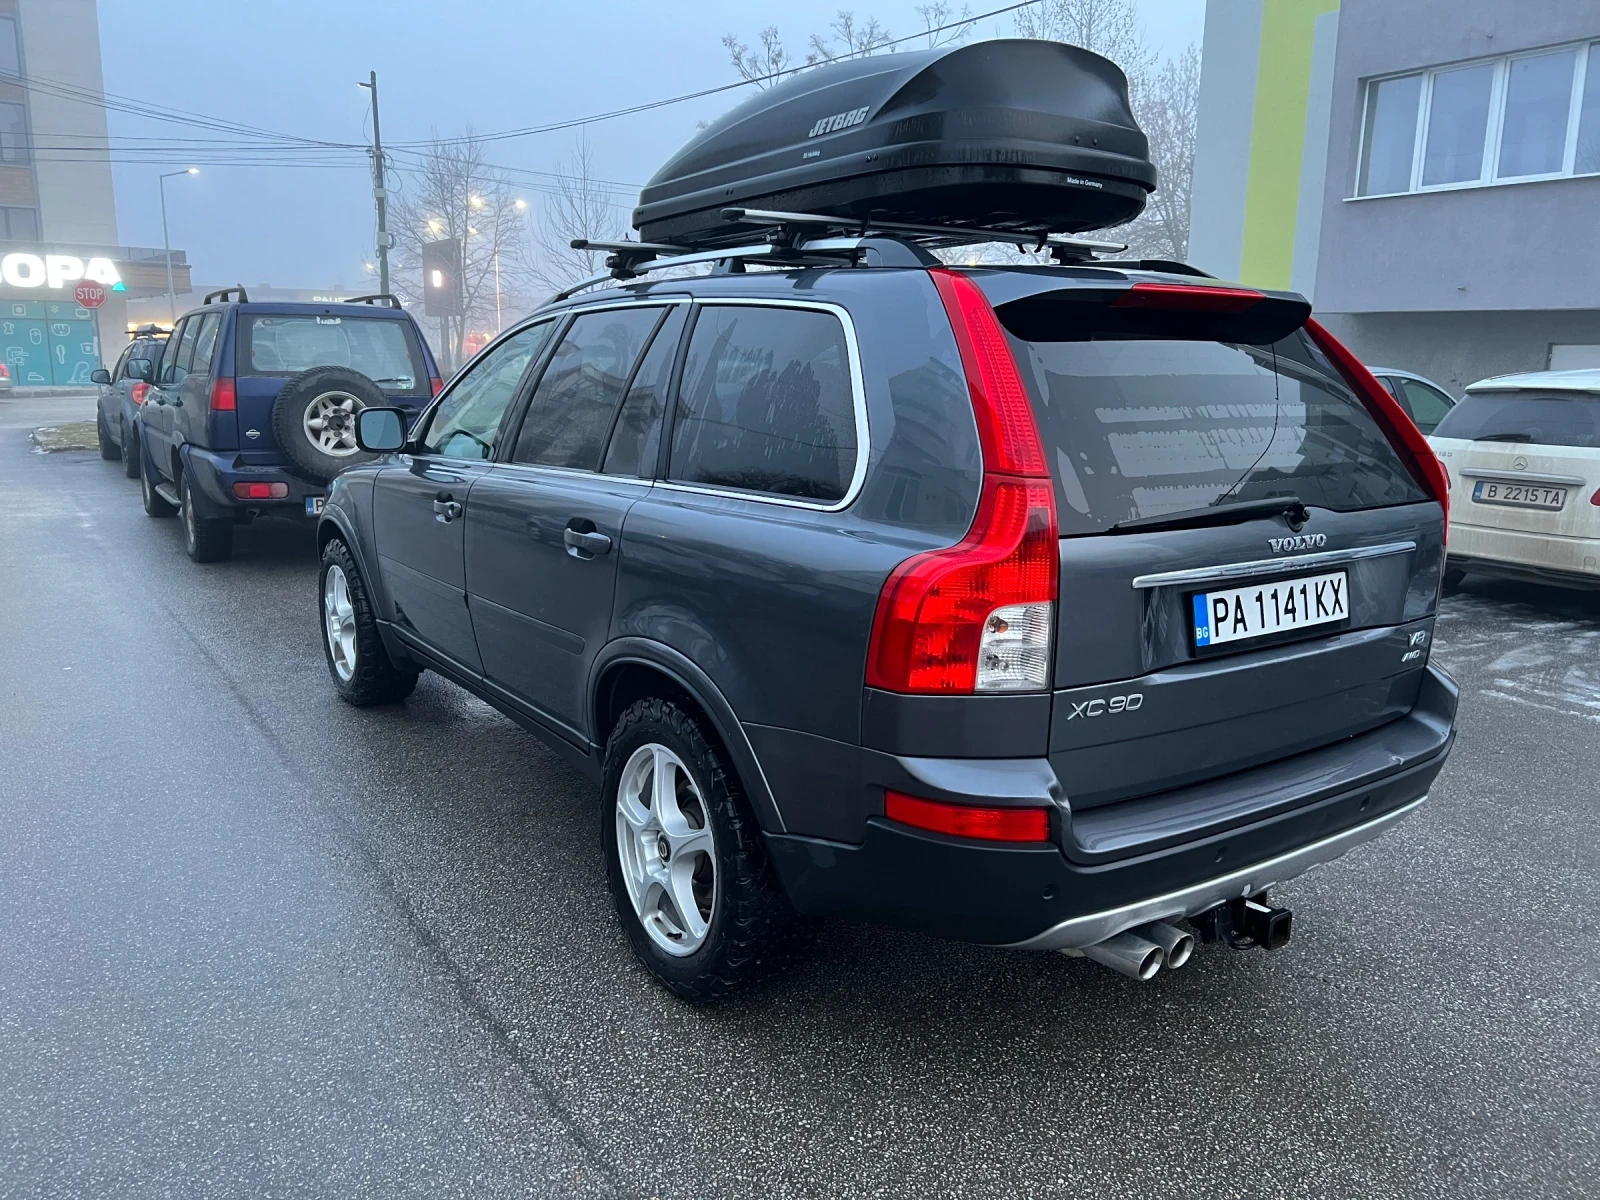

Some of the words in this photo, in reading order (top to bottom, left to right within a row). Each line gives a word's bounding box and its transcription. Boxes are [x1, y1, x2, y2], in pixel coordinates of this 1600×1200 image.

[808, 105, 870, 137] JETBAG
[1085, 180, 1103, 189] Germany
[0, 252, 123, 290] ОРА
[77, 288, 103, 300] STOP
[1487, 485, 1498, 498] B
[1503, 486, 1539, 502] 2215
[1543, 490, 1560, 505] TA
[1268, 533, 1327, 553] VOLVO
[1196, 627, 1209, 640] BG
[1409, 630, 1426, 646] V8
